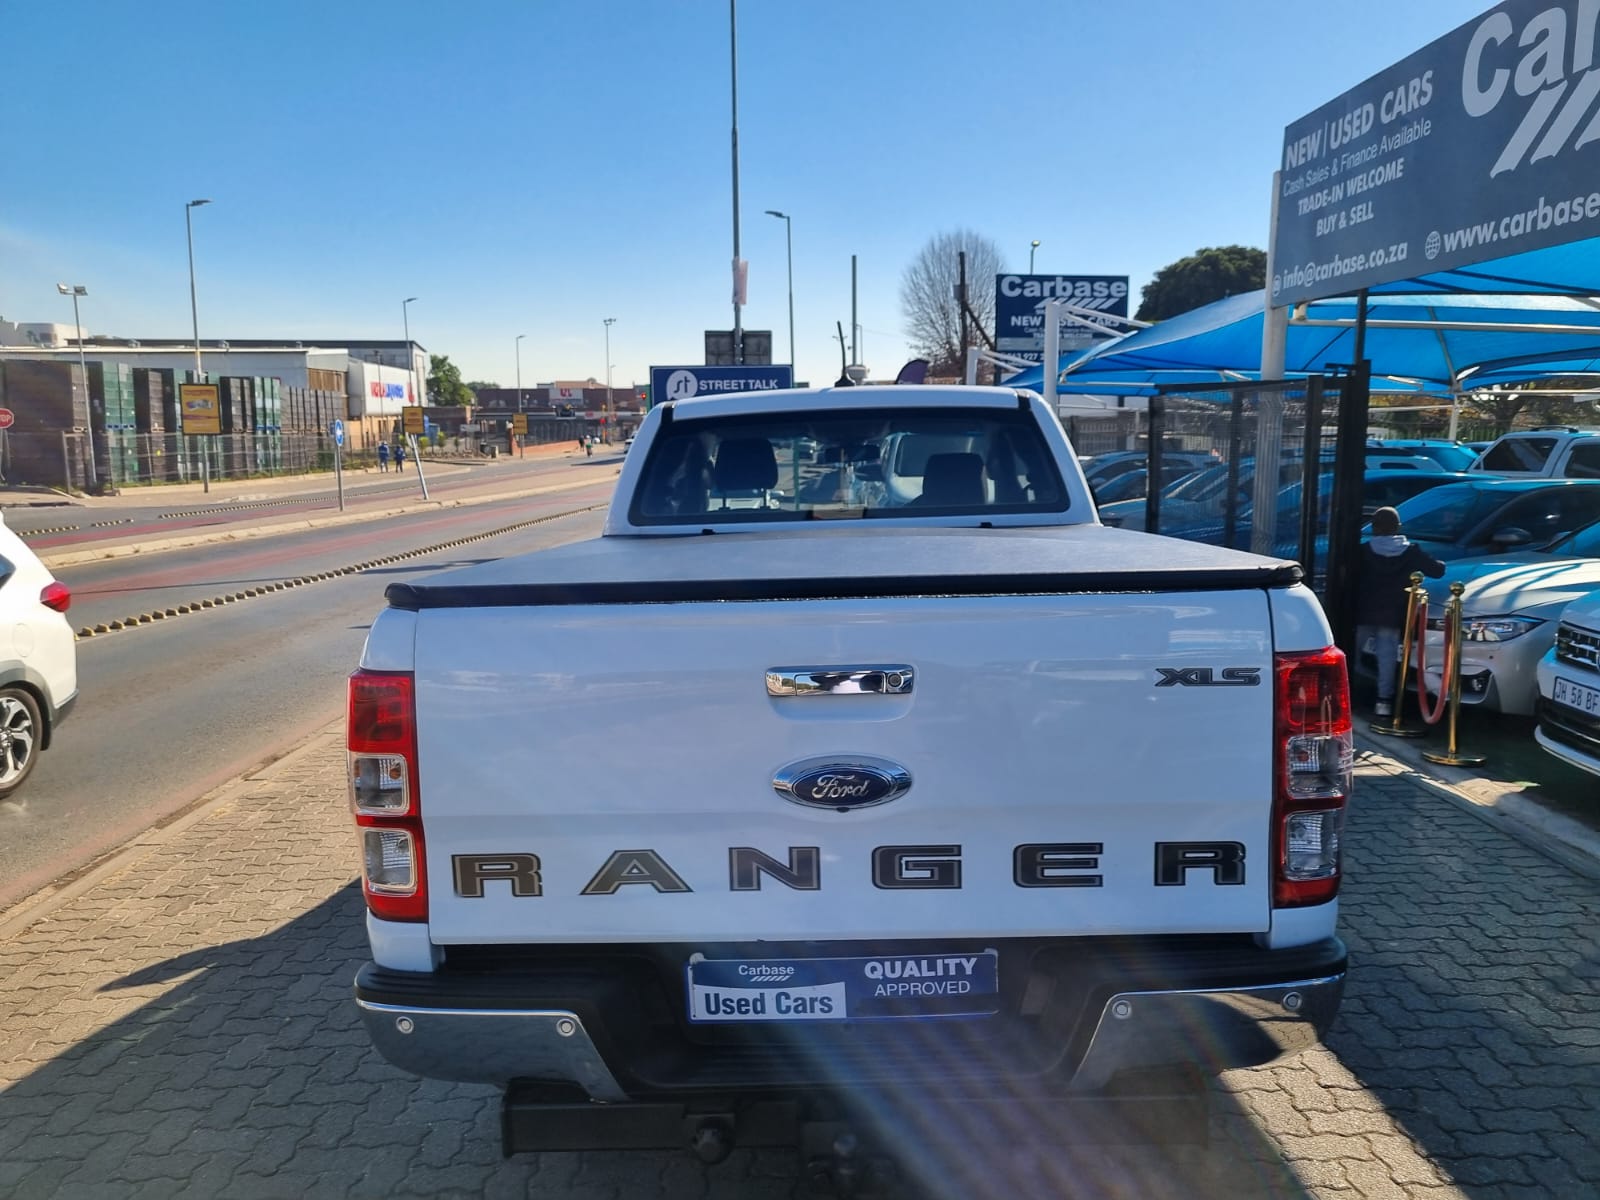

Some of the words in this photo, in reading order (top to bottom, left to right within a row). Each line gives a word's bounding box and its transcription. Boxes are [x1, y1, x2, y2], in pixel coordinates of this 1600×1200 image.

[1285, 128, 1322, 171] NEW
[1329, 102, 1375, 150] USED
[1380, 69, 1433, 124] CARS
[1283, 174, 1305, 198] Cash
[1306, 165, 1330, 189] Sales
[1331, 158, 1338, 176] &
[1340, 143, 1378, 173] Finance
[1379, 117, 1431, 156] Available
[1298, 181, 1344, 216] TRADE-IN
[1346, 157, 1405, 198] WELCOME
[1316, 213, 1337, 237] BUY
[1338, 210, 1347, 229] &
[1349, 201, 1374, 226] SELL
[1283, 240, 1408, 289] info@carbase.co.za
[1001, 275, 1127, 298] Carbase
[1010, 315, 1041, 327] NEW
[700, 379, 746, 390] STREET
[748, 379, 778, 389] TALK
[1156, 667, 1261, 687] XLS
[812, 774, 870, 799] Ford
[738, 965, 795, 976] Carbase
[864, 957, 978, 980] QUALITY
[874, 980, 971, 997] APPROVED
[704, 992, 767, 1015] Used
[775, 990, 834, 1014] Cars
